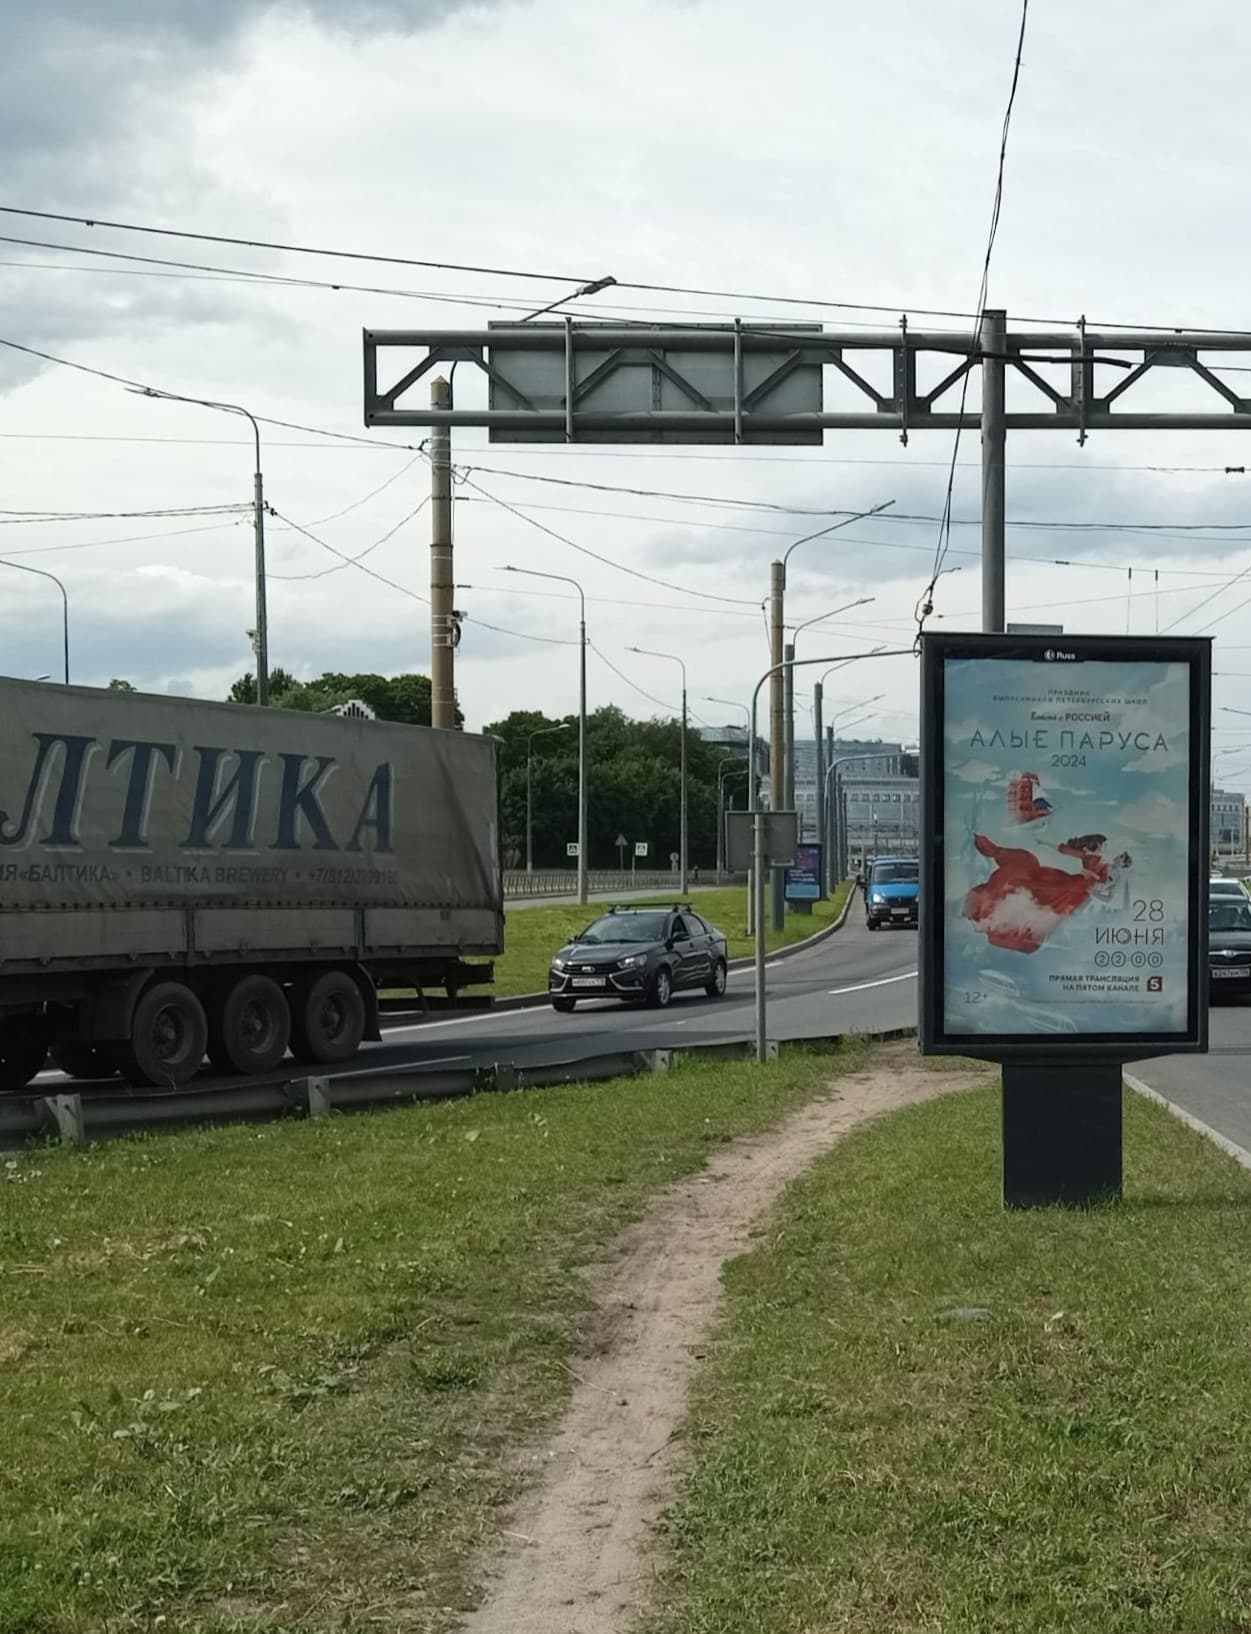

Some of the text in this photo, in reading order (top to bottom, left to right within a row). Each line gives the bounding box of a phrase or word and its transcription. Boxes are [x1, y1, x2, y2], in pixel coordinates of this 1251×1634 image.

[1065, 711, 1111, 722] РОССИЕЙ
[969, 728, 1168, 751] АЛЫЕ ПАРУСА
[1050, 754, 1087, 768] 2024
[141, 865, 209, 883] BALTIKA
[215, 866, 289, 884] BREWERY
[1132, 899, 1165, 922] 28
[1095, 927, 1164, 945] ИЮНЯ
[1085, 975, 1140, 983] ТРАНСЛЯЦИЯ
[1149, 978, 1160, 990] 5
[1075, 984, 1105, 992] ПЯТОМ
[1106, 984, 1140, 992] КАНАЛЕ
[964, 992, 988, 1004] 12+
